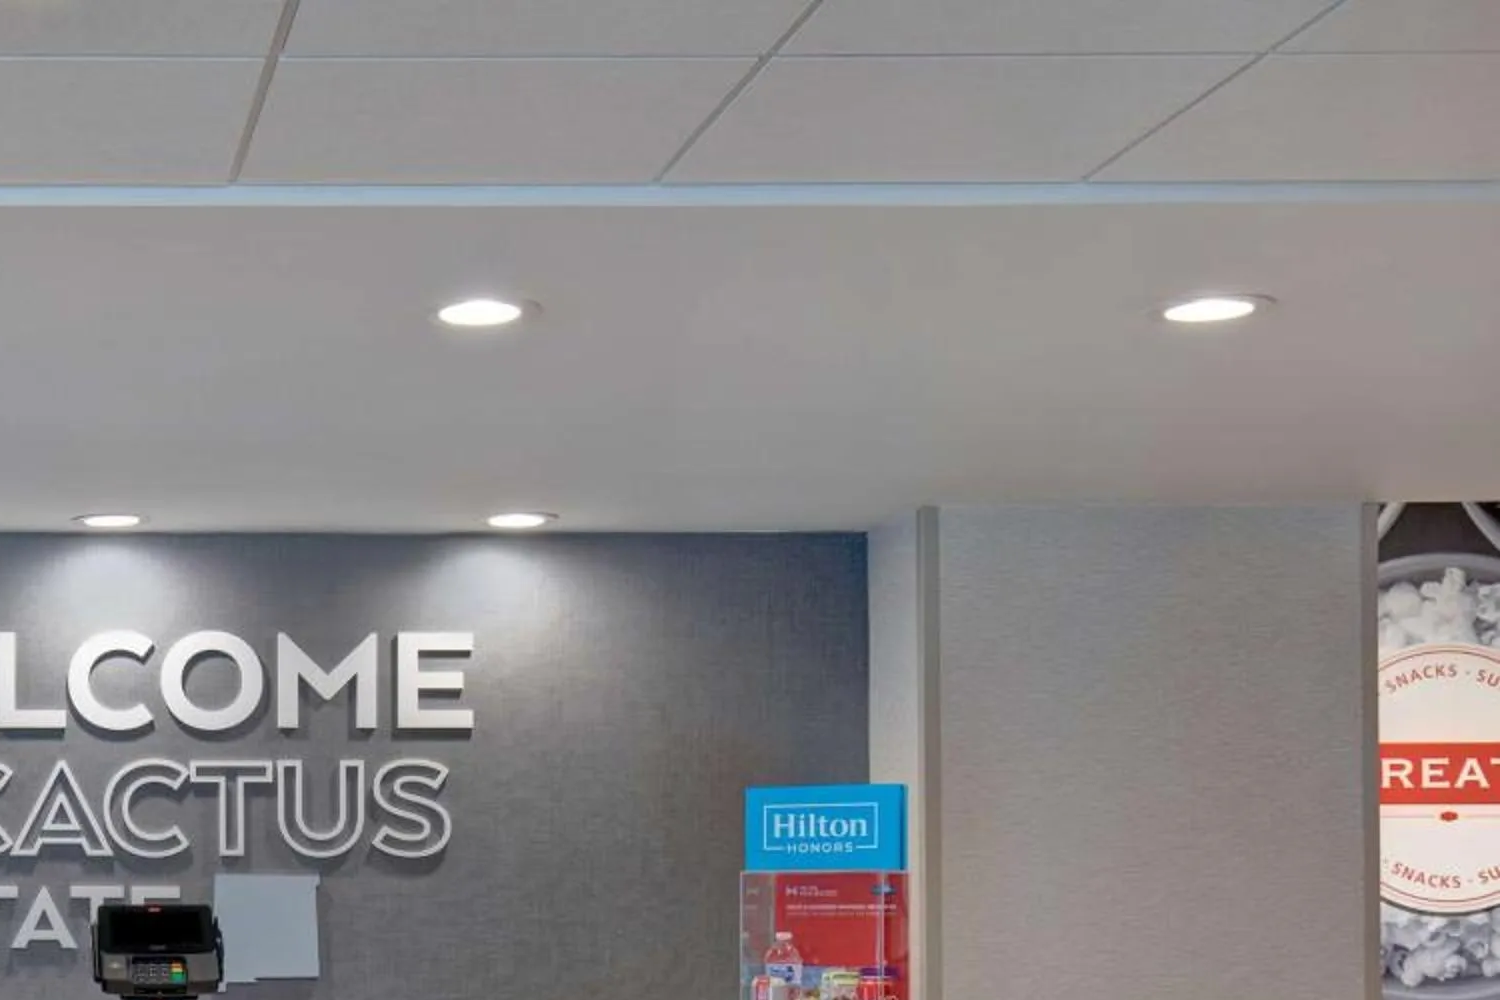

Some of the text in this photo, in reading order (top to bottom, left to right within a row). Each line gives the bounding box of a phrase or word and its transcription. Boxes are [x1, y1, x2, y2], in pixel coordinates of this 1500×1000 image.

[1384, 664, 1458, 693] SNACKS
[773, 813, 869, 838] Hilton
[787, 842, 853, 854] HONORS
[1391, 862, 1461, 889] SNACKS
